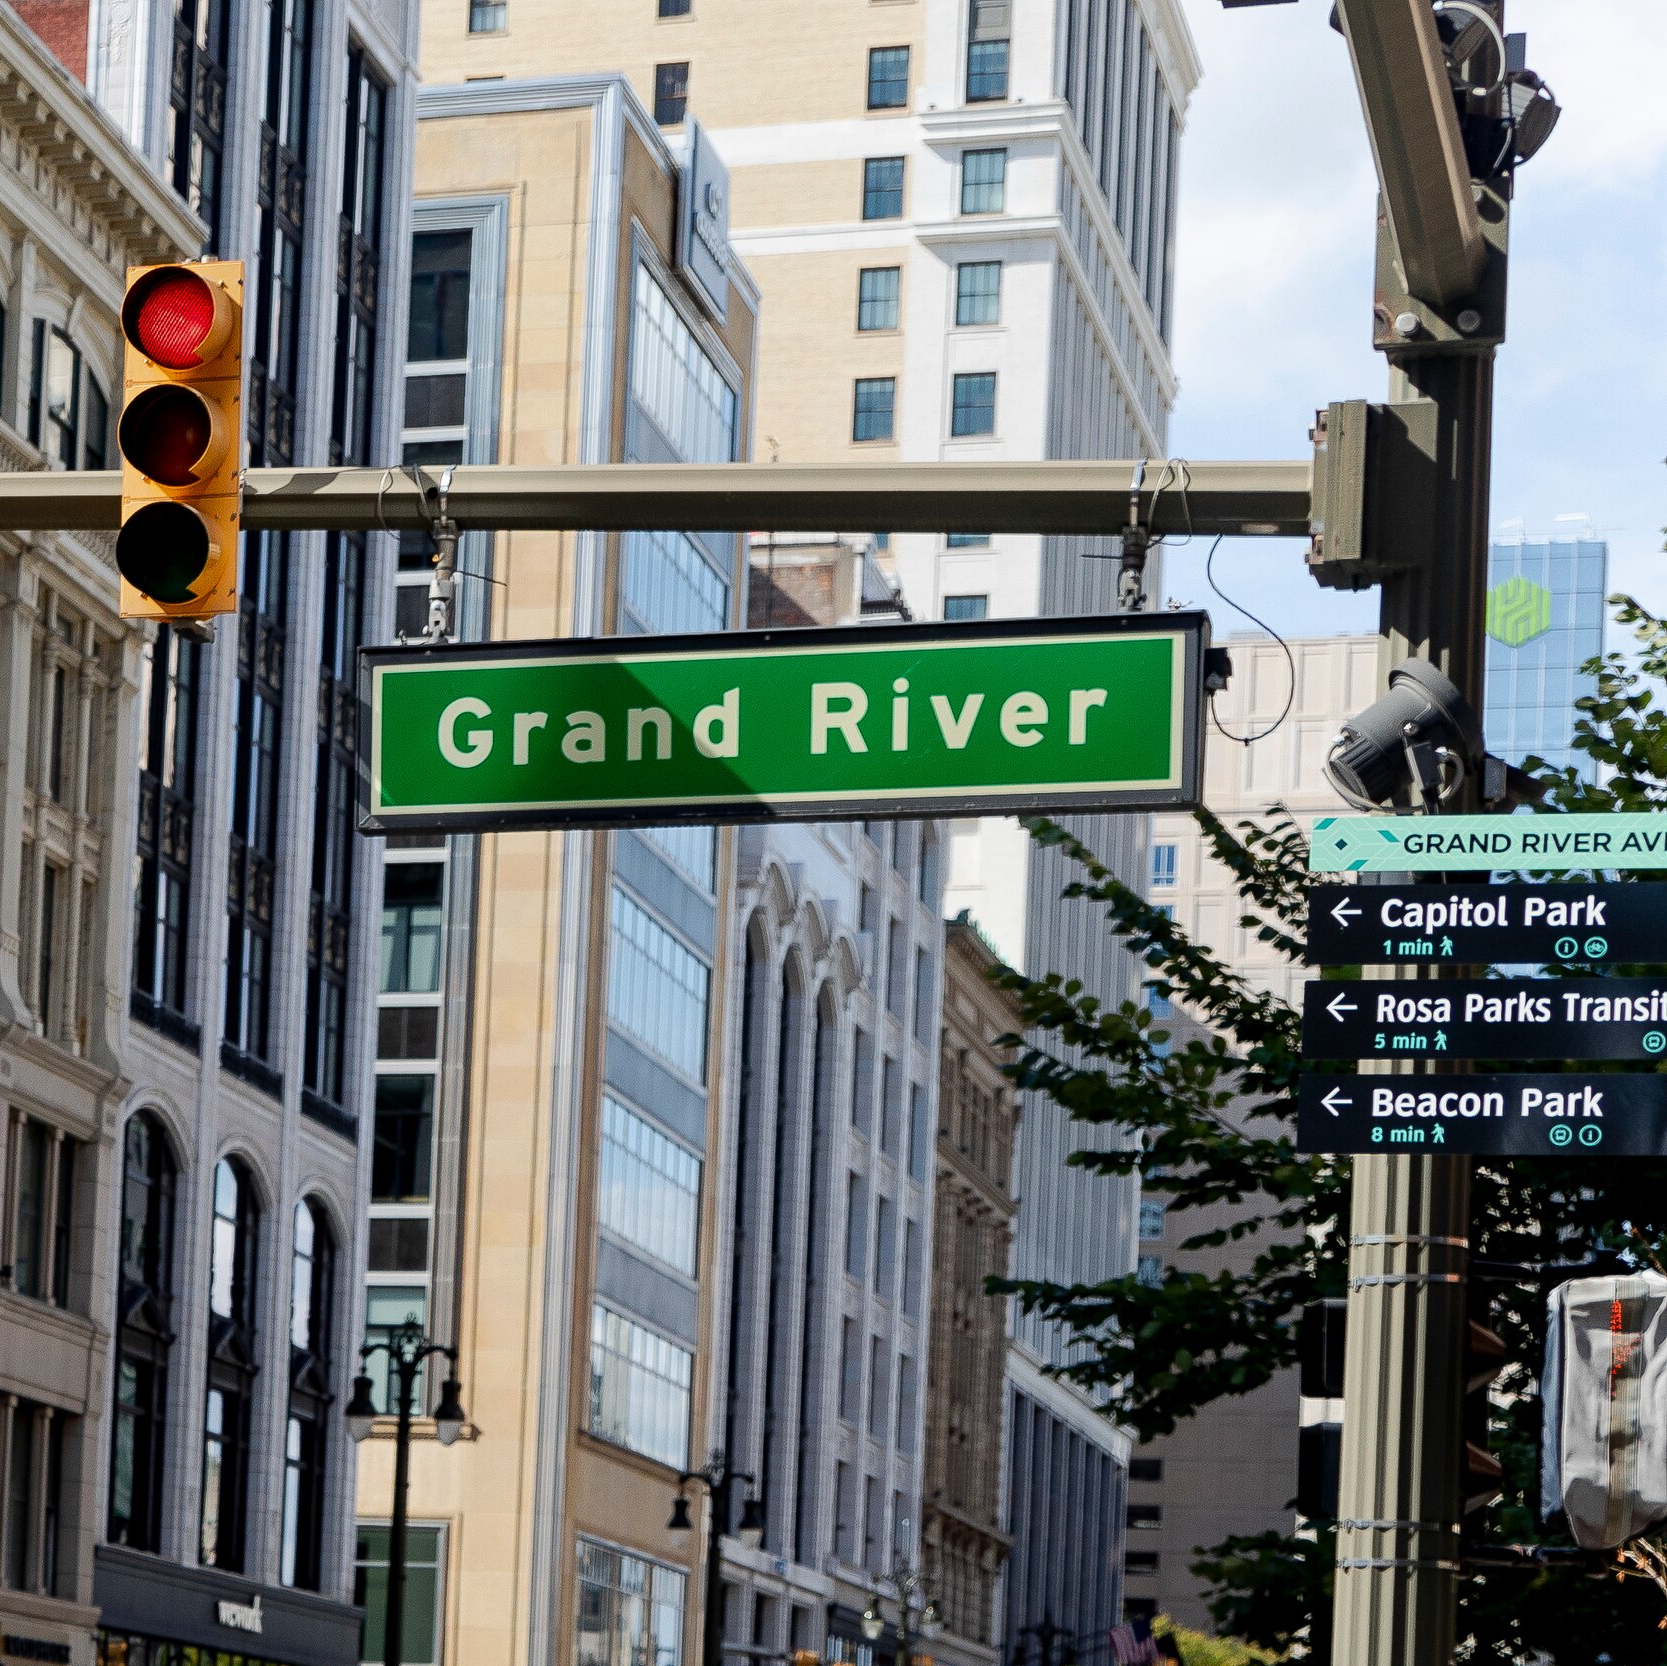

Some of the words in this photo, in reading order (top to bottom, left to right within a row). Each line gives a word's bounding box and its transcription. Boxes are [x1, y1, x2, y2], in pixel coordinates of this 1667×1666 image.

[437, 686, 741, 770] Grand
[810, 677, 1110, 758] River
[1403, 832, 1512, 855] GRAND
[1521, 831, 1612, 853] RIVER
[1620, 831, 1667, 852] AV
[1380, 895, 1509, 935] Capitol
[1523, 894, 1607, 927] Park
[1382, 939, 1392, 956] 1
[1397, 938, 1433, 956] min
[1375, 993, 1451, 1023] Rosa
[1464, 990, 1552, 1023] Parks
[1374, 1032, 1386, 1049] 5
[1392, 1031, 1427, 1049] min
[1371, 1086, 1504, 1118] Beacon
[1520, 1085, 1604, 1118] Park
[1371, 1126, 1383, 1143] 8
[1389, 1124, 1425, 1143] min
